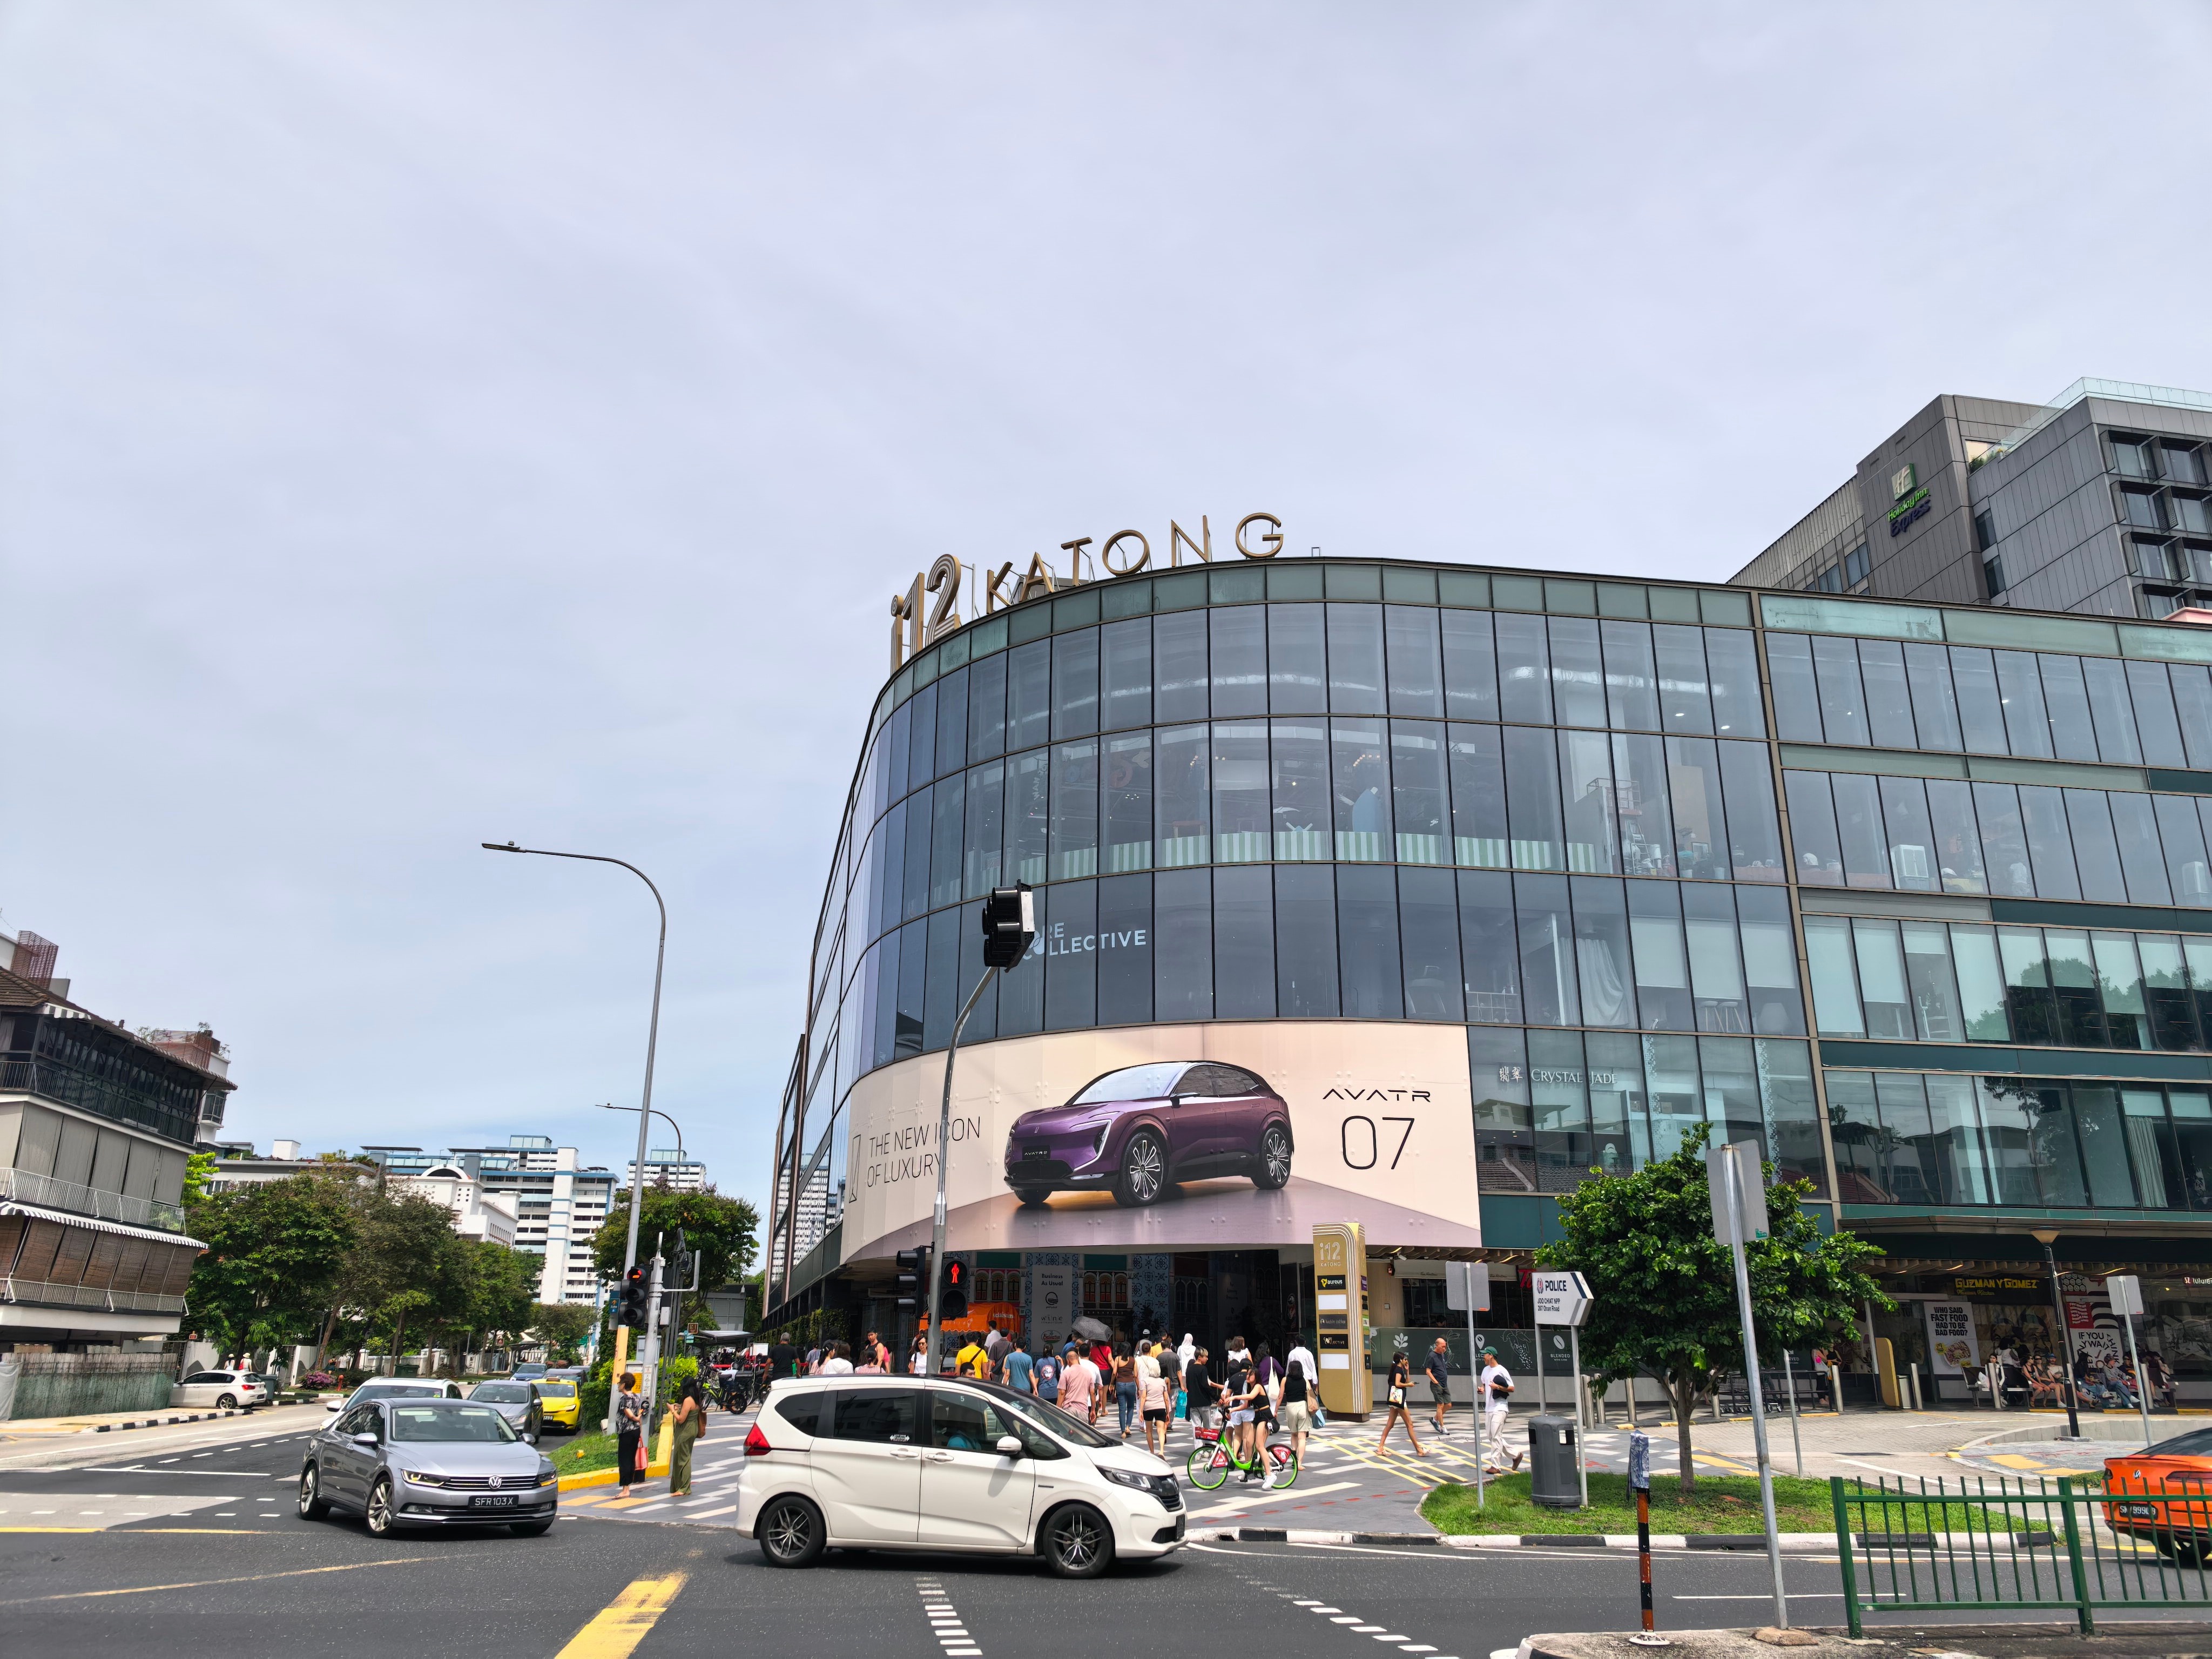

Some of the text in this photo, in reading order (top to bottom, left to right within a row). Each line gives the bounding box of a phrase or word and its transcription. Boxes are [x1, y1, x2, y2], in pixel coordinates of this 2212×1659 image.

[1887, 487, 1930, 522] Holiday Inn
[986, 512, 1284, 615] KATONG
[1531, 1069, 1618, 1086] CRYSTAL JADE
[1323, 1088, 1431, 1103] AVATR
[869, 1132, 891, 1158] THE
[894, 1124, 929, 1152] NEW
[1341, 1116, 1415, 1170] 07
[867, 1164, 882, 1188] OF
[1545, 1280, 1567, 1291] POLICE
[1954, 1278, 2038, 1289] GUZMAN Y GOMEZ
[1949, 1314, 1968, 1322] FOOD
[2078, 1332, 2085, 1340] IF
[2086, 1332, 2104, 1340] YOU
[475, 1497, 514, 1506] SFR103X
